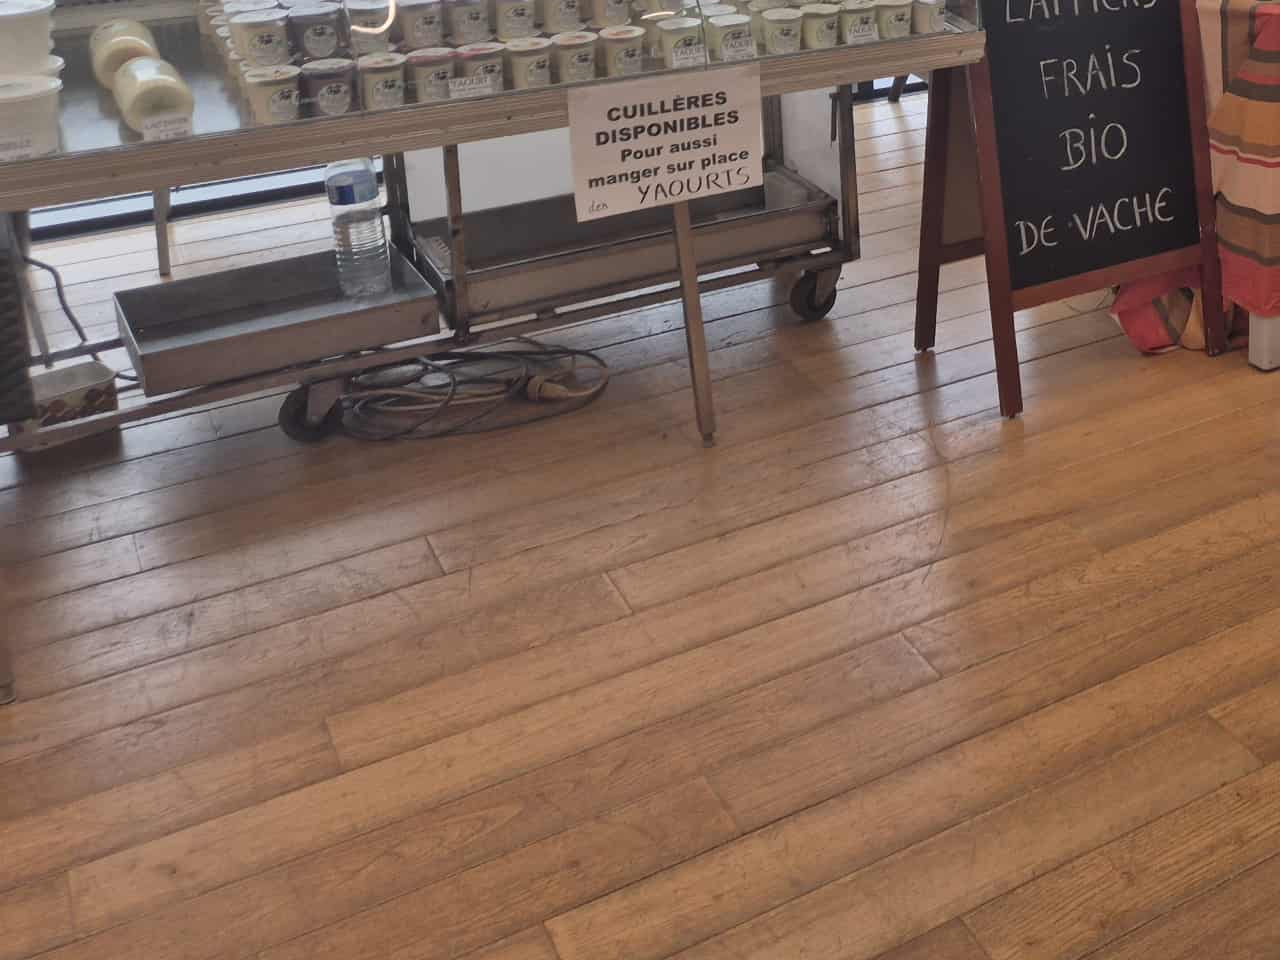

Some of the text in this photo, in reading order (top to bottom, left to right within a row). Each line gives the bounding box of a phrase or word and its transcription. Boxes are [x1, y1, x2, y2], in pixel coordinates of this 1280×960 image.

[595, 110, 740, 146] DISPONIBLES
[620, 134, 718, 162] Pour aussi
[588, 150, 750, 189] manger sur place
[637, 166, 751, 205] YAOURTS
[1015, 187, 1175, 256] DE VACHE
